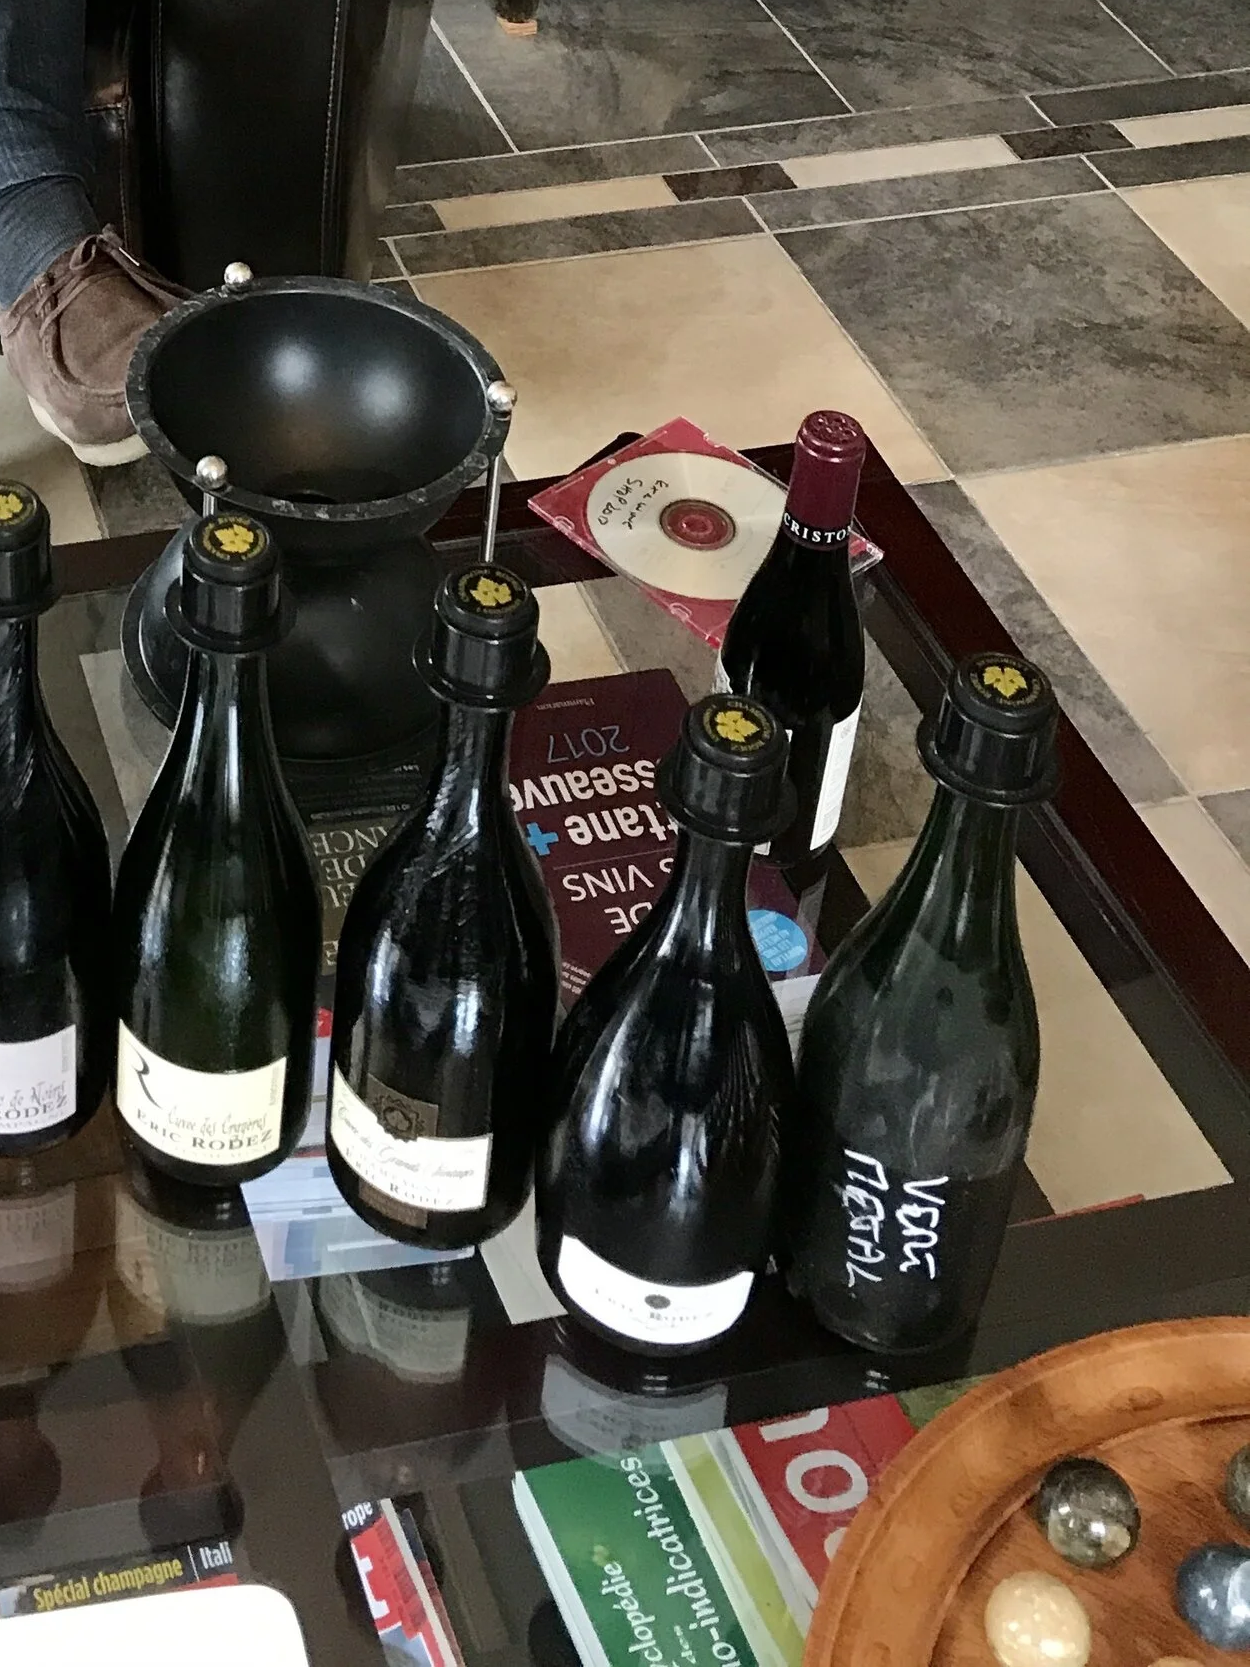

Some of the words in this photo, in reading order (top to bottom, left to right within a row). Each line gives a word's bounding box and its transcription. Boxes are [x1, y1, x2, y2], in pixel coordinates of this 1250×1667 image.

[547, 725, 630, 764] 2017
[509, 758, 661, 812] sseauve
[562, 864, 655, 902] VINS
[136, 1107, 182, 1143] ERIC
[191, 1128, 273, 1151] RODEZ
[33, 1576, 92, 1611] Spécial
[93, 1558, 183, 1597] champagne
